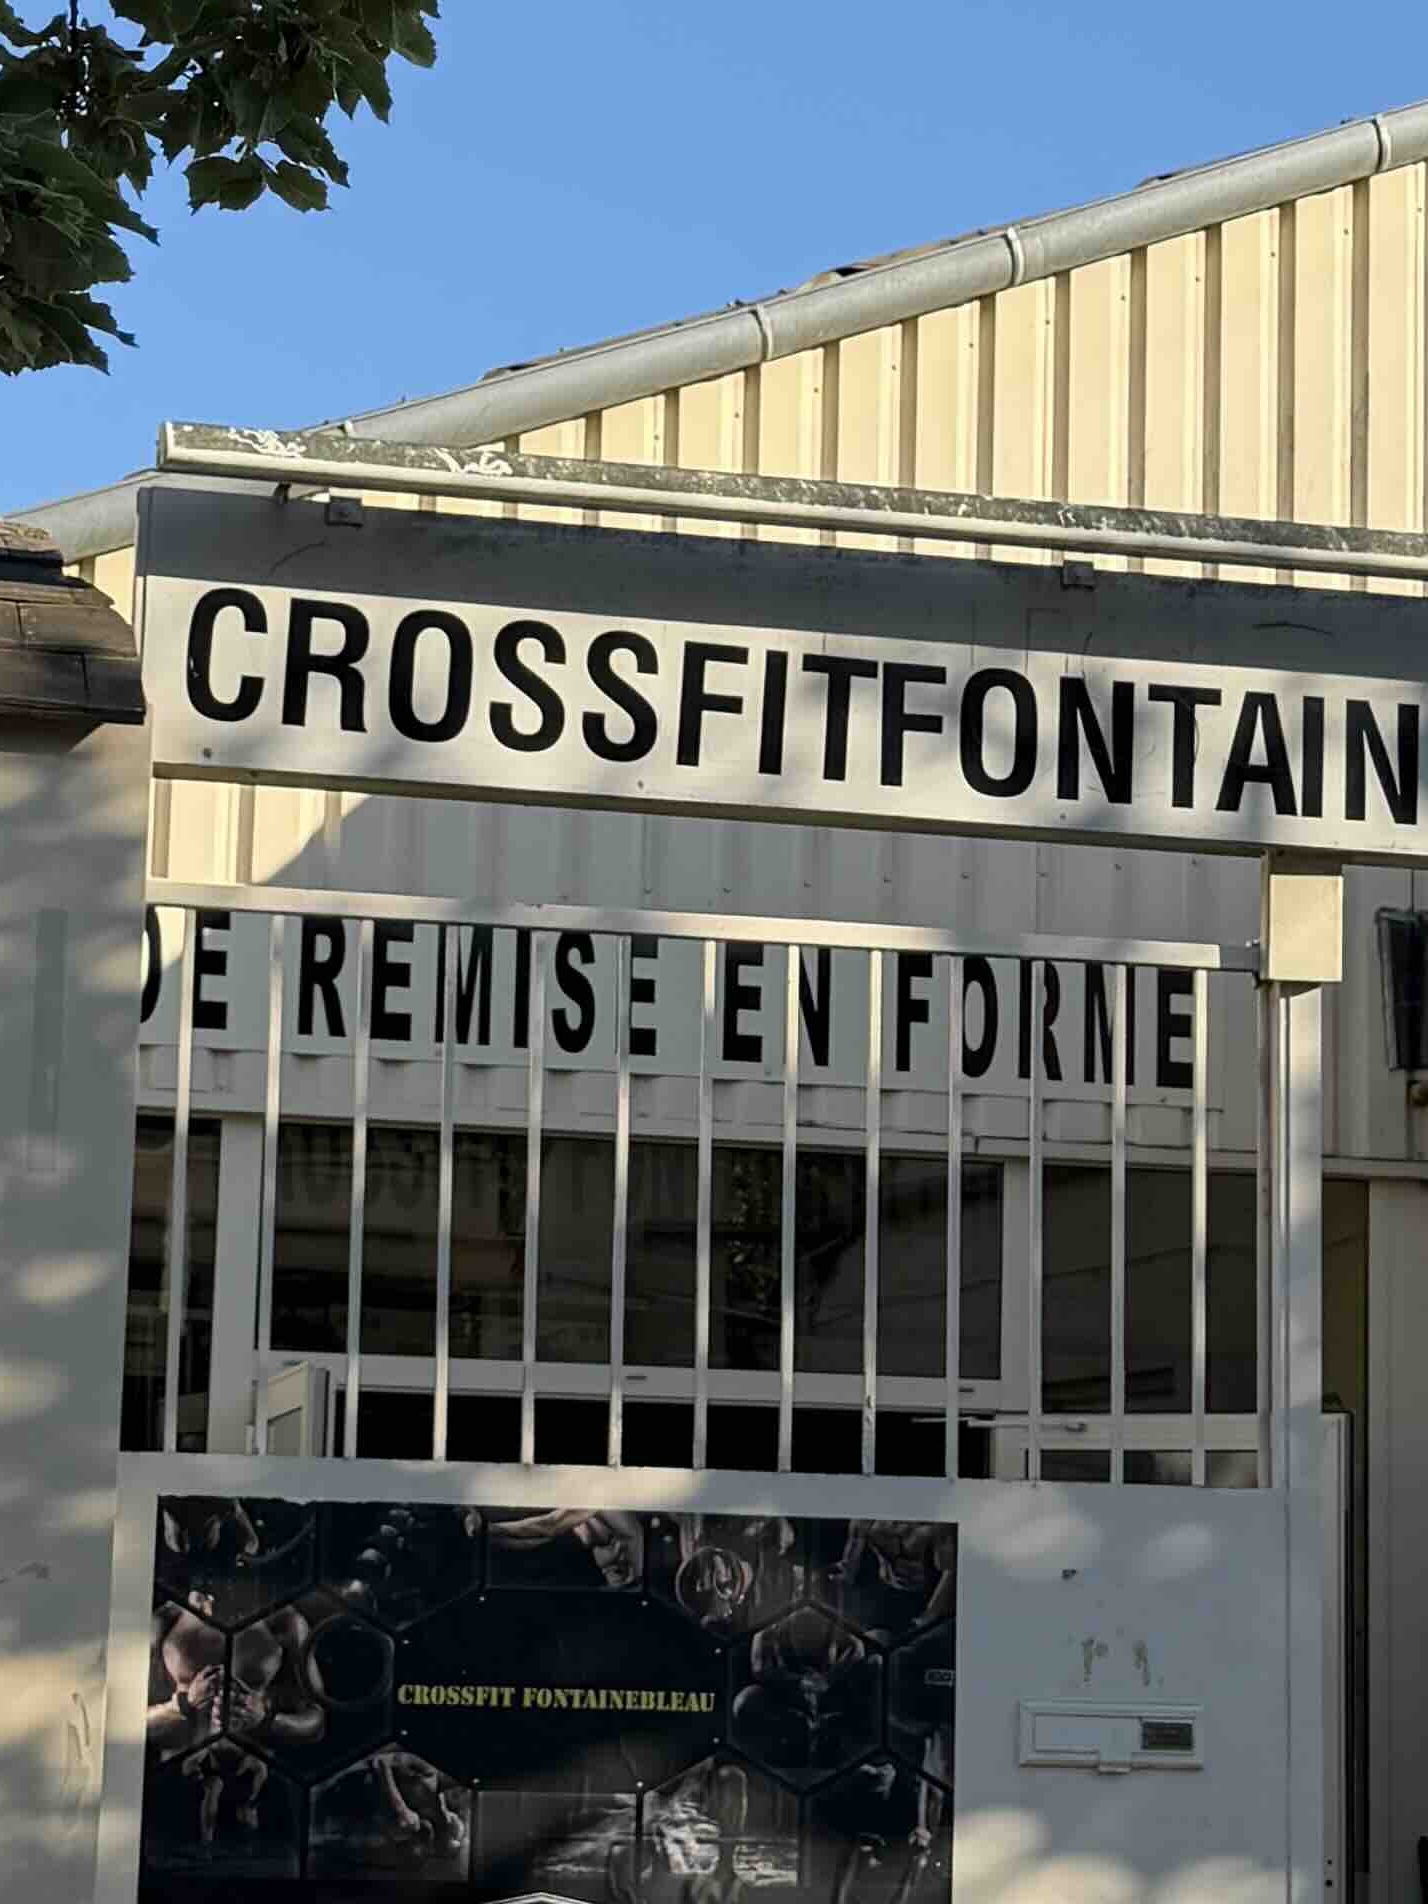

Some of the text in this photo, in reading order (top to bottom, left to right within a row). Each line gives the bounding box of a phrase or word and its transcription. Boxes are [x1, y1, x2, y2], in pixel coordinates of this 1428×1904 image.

[297, 915, 660, 1058] REMISE
[721, 942, 833, 1068] EN
[895, 952, 1196, 1089] FORME
[396, 1683, 716, 1713] CROSSFIT FONTAINEBLEAU
